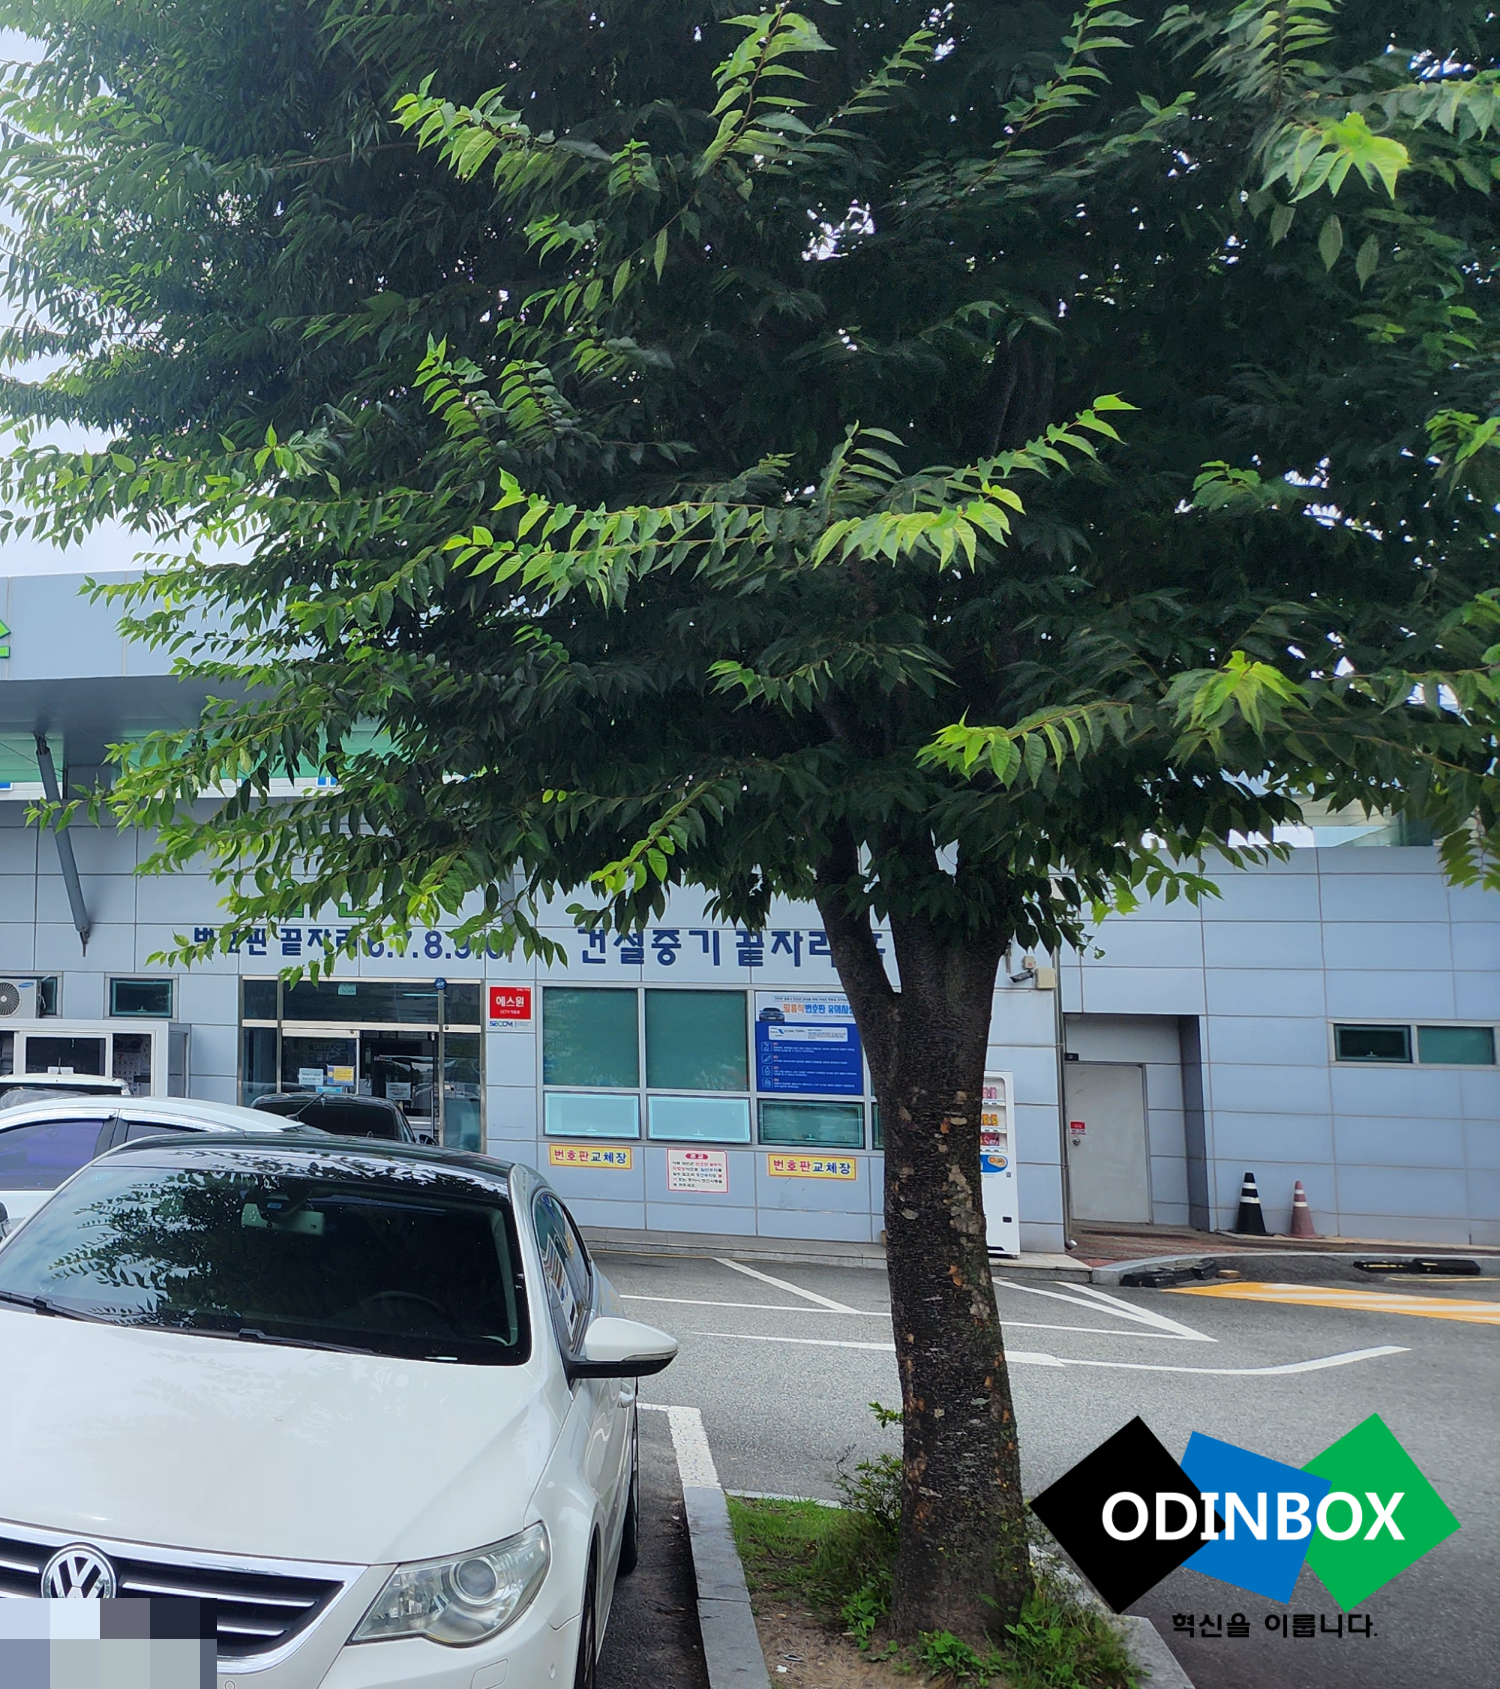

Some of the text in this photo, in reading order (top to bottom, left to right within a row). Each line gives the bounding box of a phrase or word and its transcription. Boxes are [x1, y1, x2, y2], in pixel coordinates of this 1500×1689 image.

[577, 928, 721, 967] 건설중기
[495, 996, 525, 1008] 에스원
[553, 1149, 627, 1164] 번호판교체장
[772, 1158, 852, 1176] 번호판교체장
